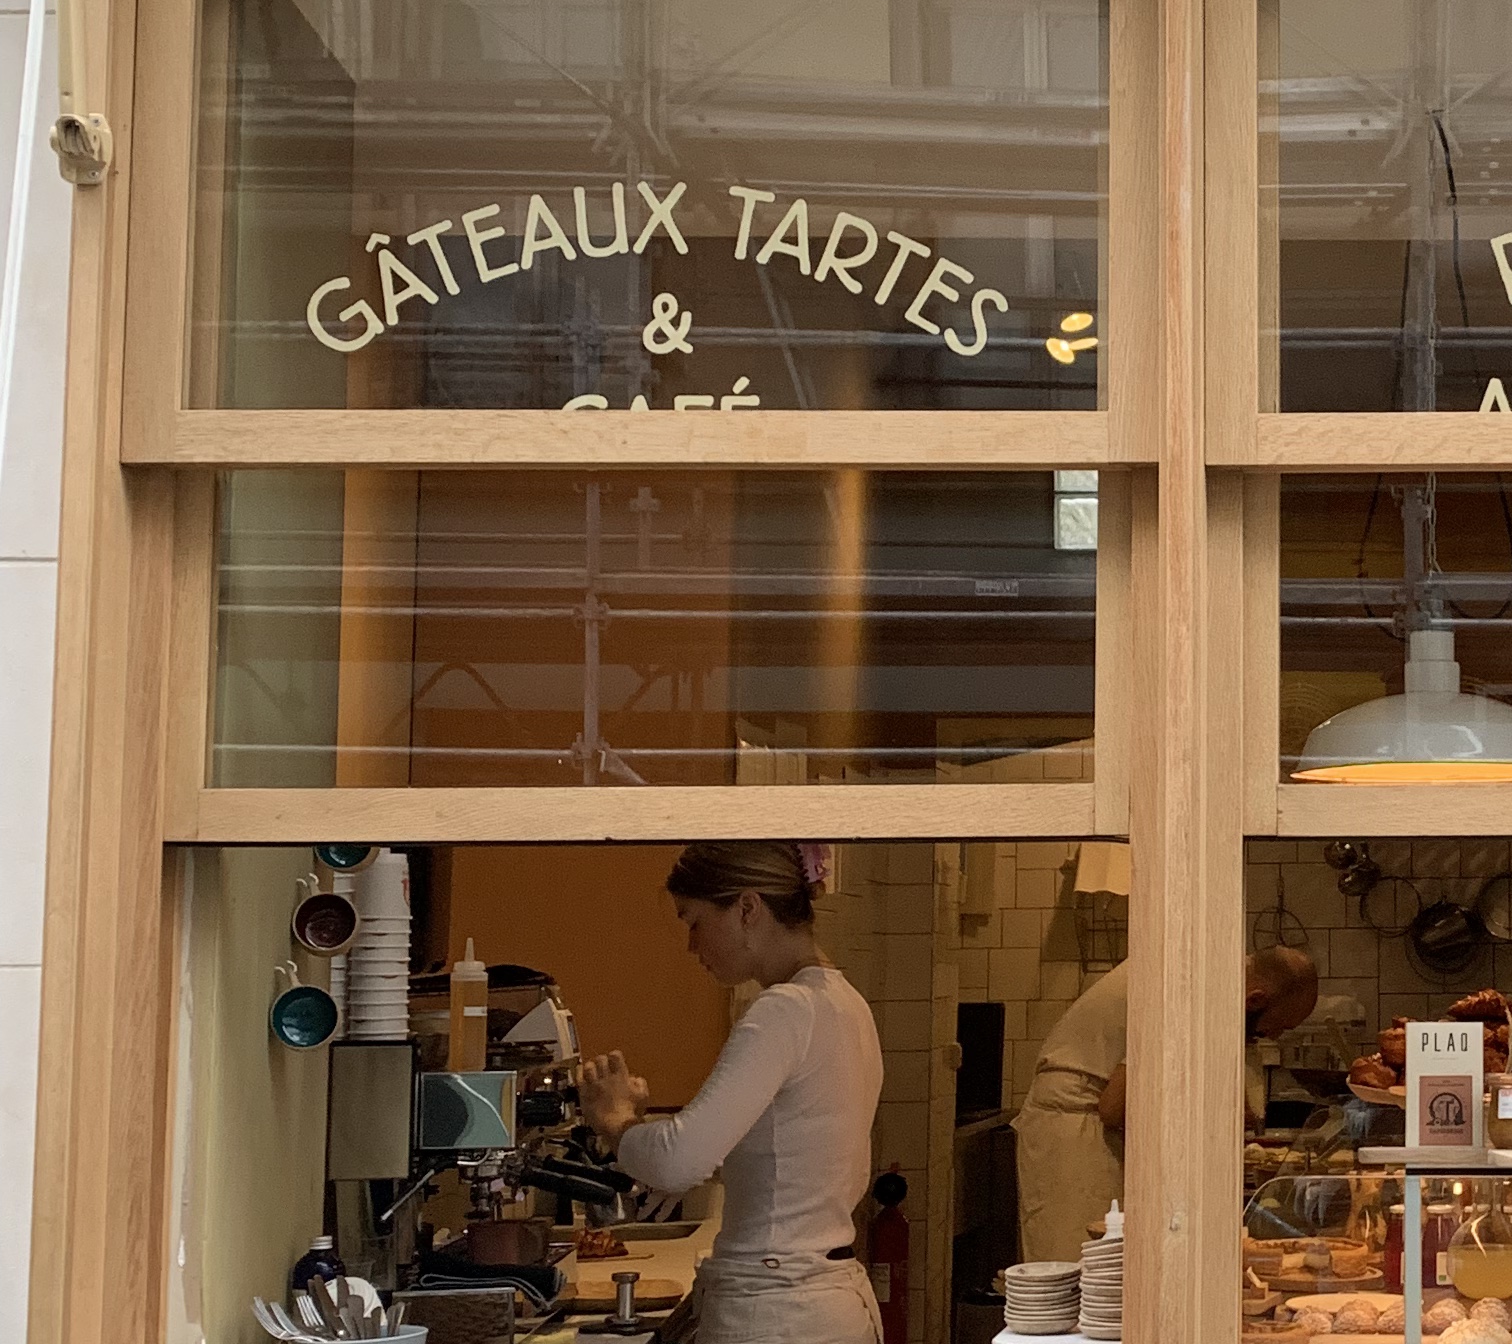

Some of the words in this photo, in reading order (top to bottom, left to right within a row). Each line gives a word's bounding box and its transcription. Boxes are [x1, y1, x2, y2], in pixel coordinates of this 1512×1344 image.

[306, 181, 689, 353] GÂTEAUX
[728, 184, 1009, 358] TARTES
[642, 292, 694, 355] &
[1421, 1032, 1469, 1053] PLAQ
